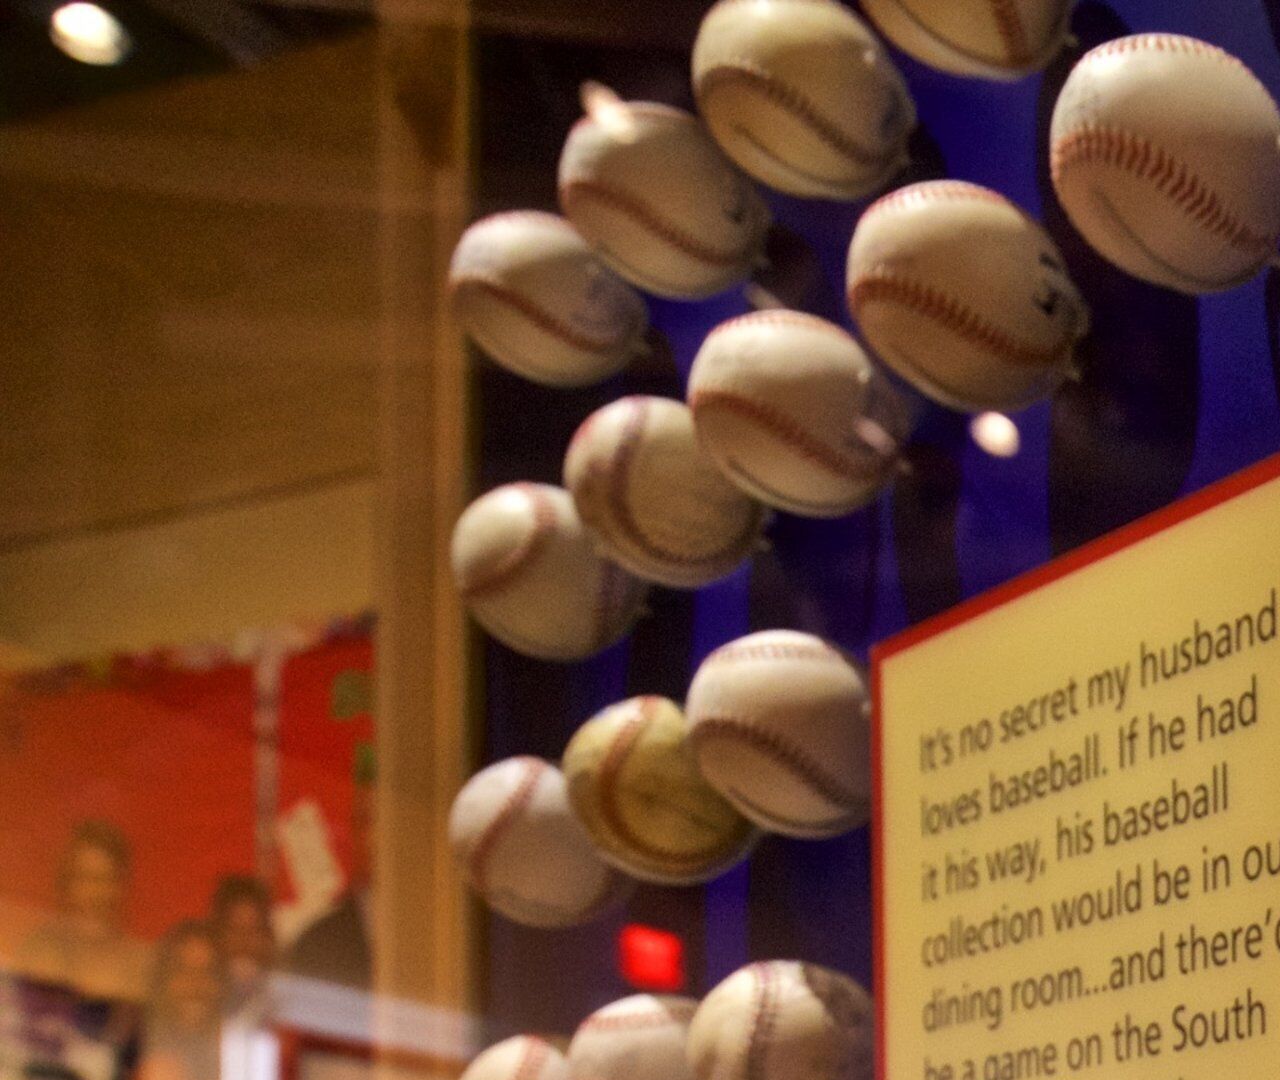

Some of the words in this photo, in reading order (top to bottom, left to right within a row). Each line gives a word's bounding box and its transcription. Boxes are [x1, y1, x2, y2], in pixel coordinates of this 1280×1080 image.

[920, 727, 953, 774] It's
[958, 718, 994, 759] no
[999, 677, 1079, 744] secret
[1087, 662, 1131, 712] my
[1140, 587, 1278, 689] husband
[920, 788, 983, 839] loves
[988, 732, 1108, 816] baseball.
[1118, 716, 1140, 770] If
[1148, 712, 1187, 760] he
[1197, 673, 1259, 743] had
[920, 860, 938, 903] it
[944, 848, 979, 896] his
[985, 836, 1047, 885] way,
[1056, 811, 1095, 863] his
[1103, 761, 1230, 848] baseball
[921, 903, 1044, 968] collection
[1051, 863, 1143, 933] would
[1153, 859, 1192, 907] be
[1201, 845, 1231, 894] in
[921, 983, 1003, 1034] dining
[1066, 1032, 1102, 1072] on
[1112, 1013, 1163, 1064] the
[1171, 987, 1268, 1053] South
